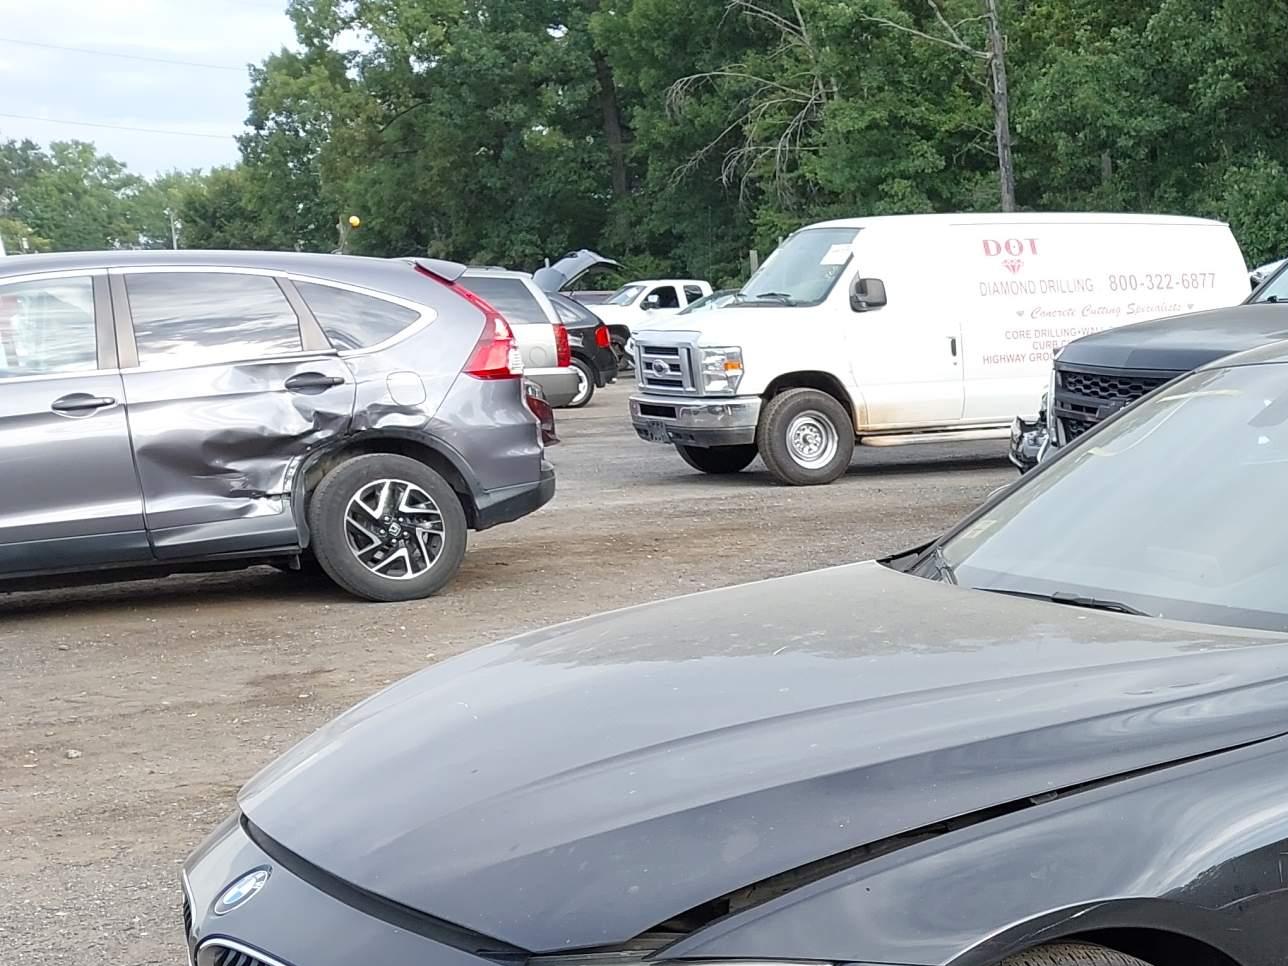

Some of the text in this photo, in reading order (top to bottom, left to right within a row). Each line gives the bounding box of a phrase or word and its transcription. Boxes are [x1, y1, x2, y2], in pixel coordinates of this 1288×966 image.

[981, 238, 1039, 257] DOT
[979, 278, 1094, 297] DIAMOND DRILLING
[1108, 272, 1217, 292] 800-322-6877
[1004, 330, 1032, 340] CORE
[982, 353, 1027, 365] HIGHWAY
